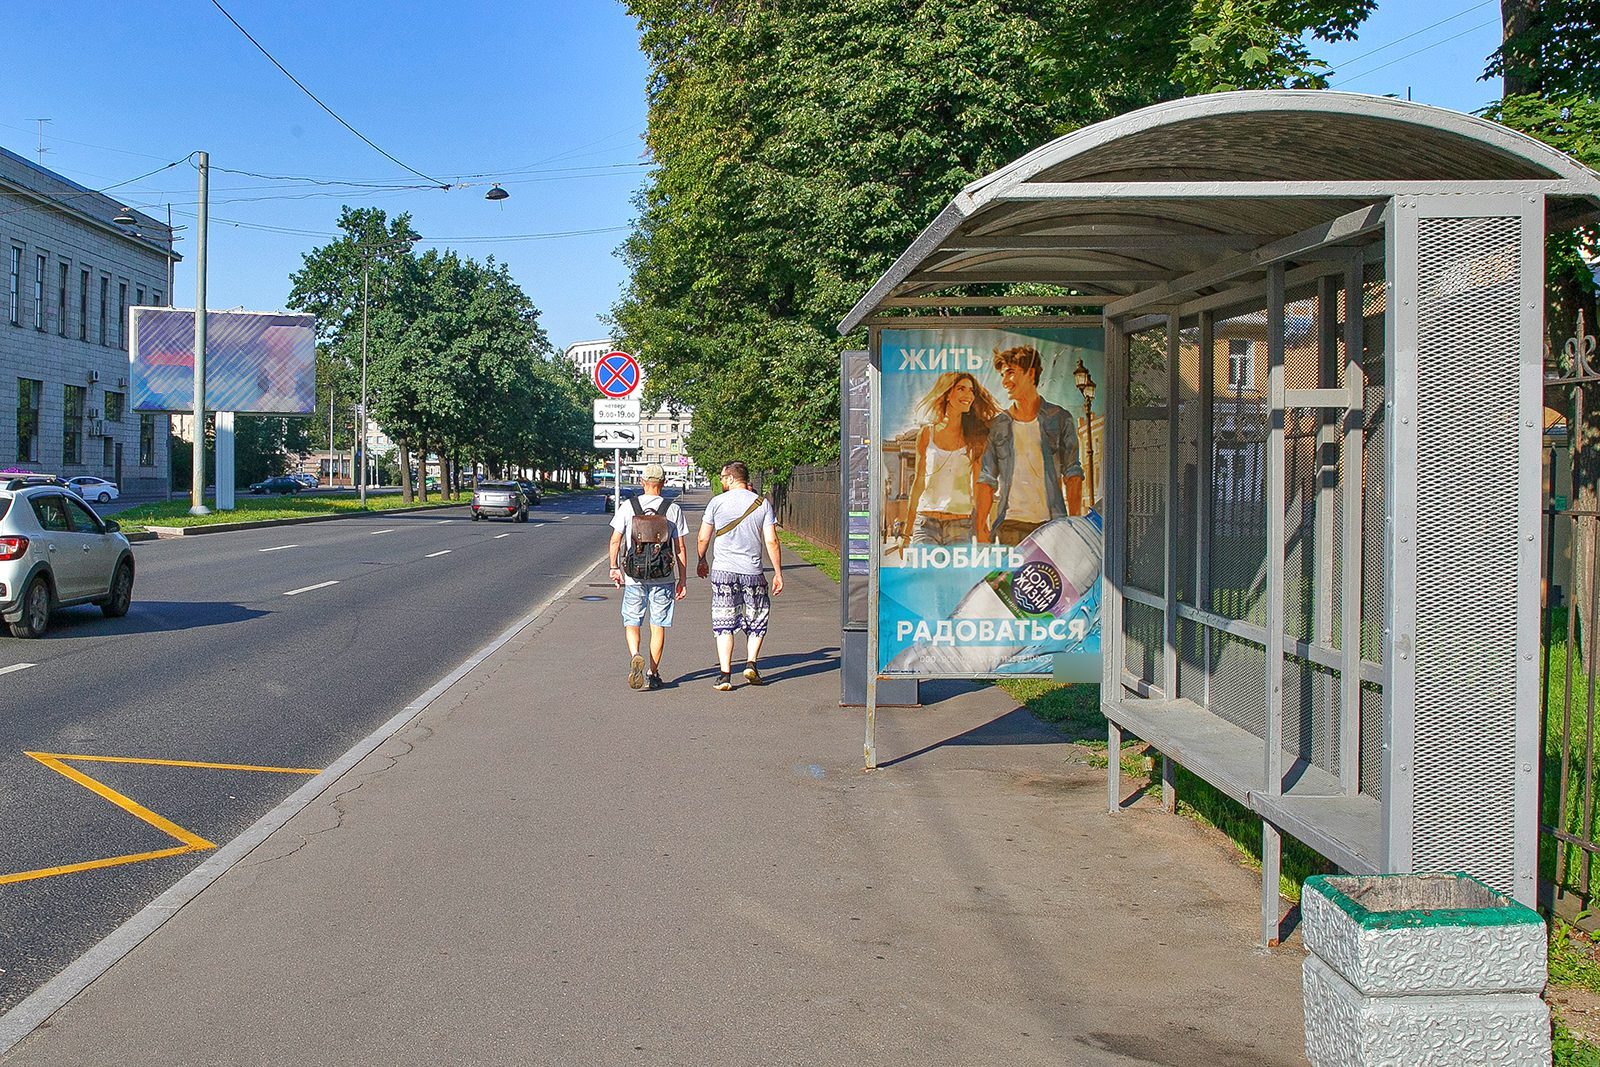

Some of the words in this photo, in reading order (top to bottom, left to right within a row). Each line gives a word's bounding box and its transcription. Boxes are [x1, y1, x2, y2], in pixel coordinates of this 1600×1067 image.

[899, 348, 984, 370] ЖИТЬ
[900, 546, 1025, 569] ЛЮБИТЬ
[1013, 572, 1050, 612] ЖИЗНИ
[1022, 564, 1057, 604] НОРМА
[897, 619, 1086, 646] РАДОВАТЬСЯ
